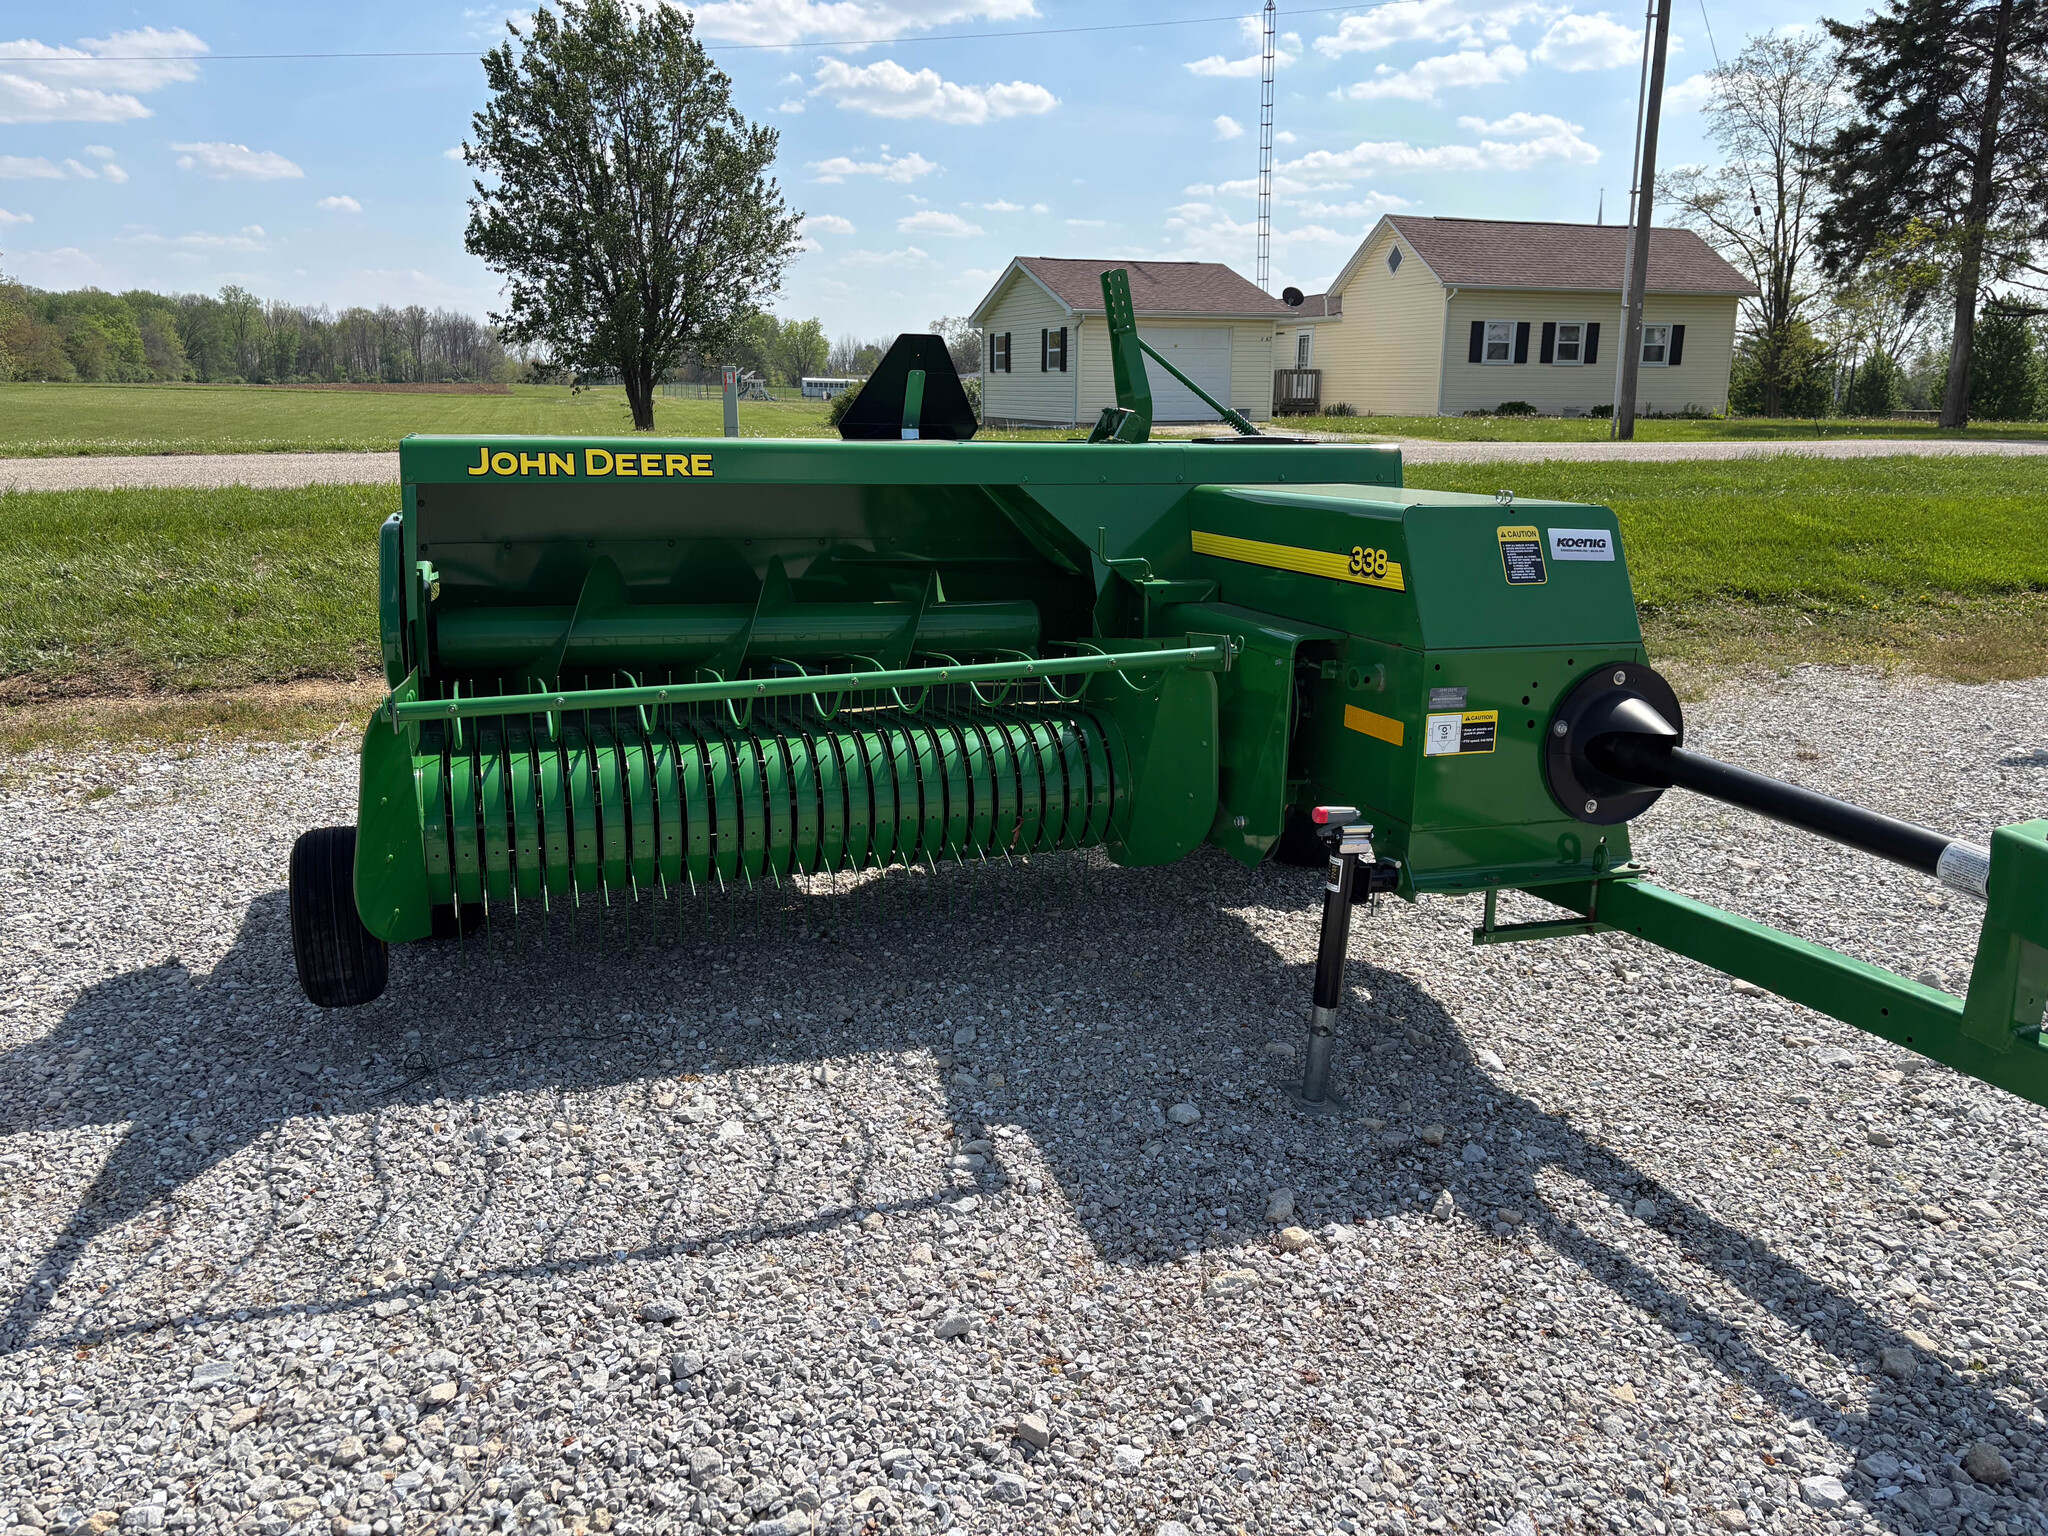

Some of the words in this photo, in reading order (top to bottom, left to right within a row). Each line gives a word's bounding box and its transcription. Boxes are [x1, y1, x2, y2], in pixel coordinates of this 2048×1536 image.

[467, 447, 576, 476] JOHN
[584, 448, 714, 477] DEERE
[1507, 530, 1537, 538] CAUTION
[1350, 545, 1388, 577] 338
